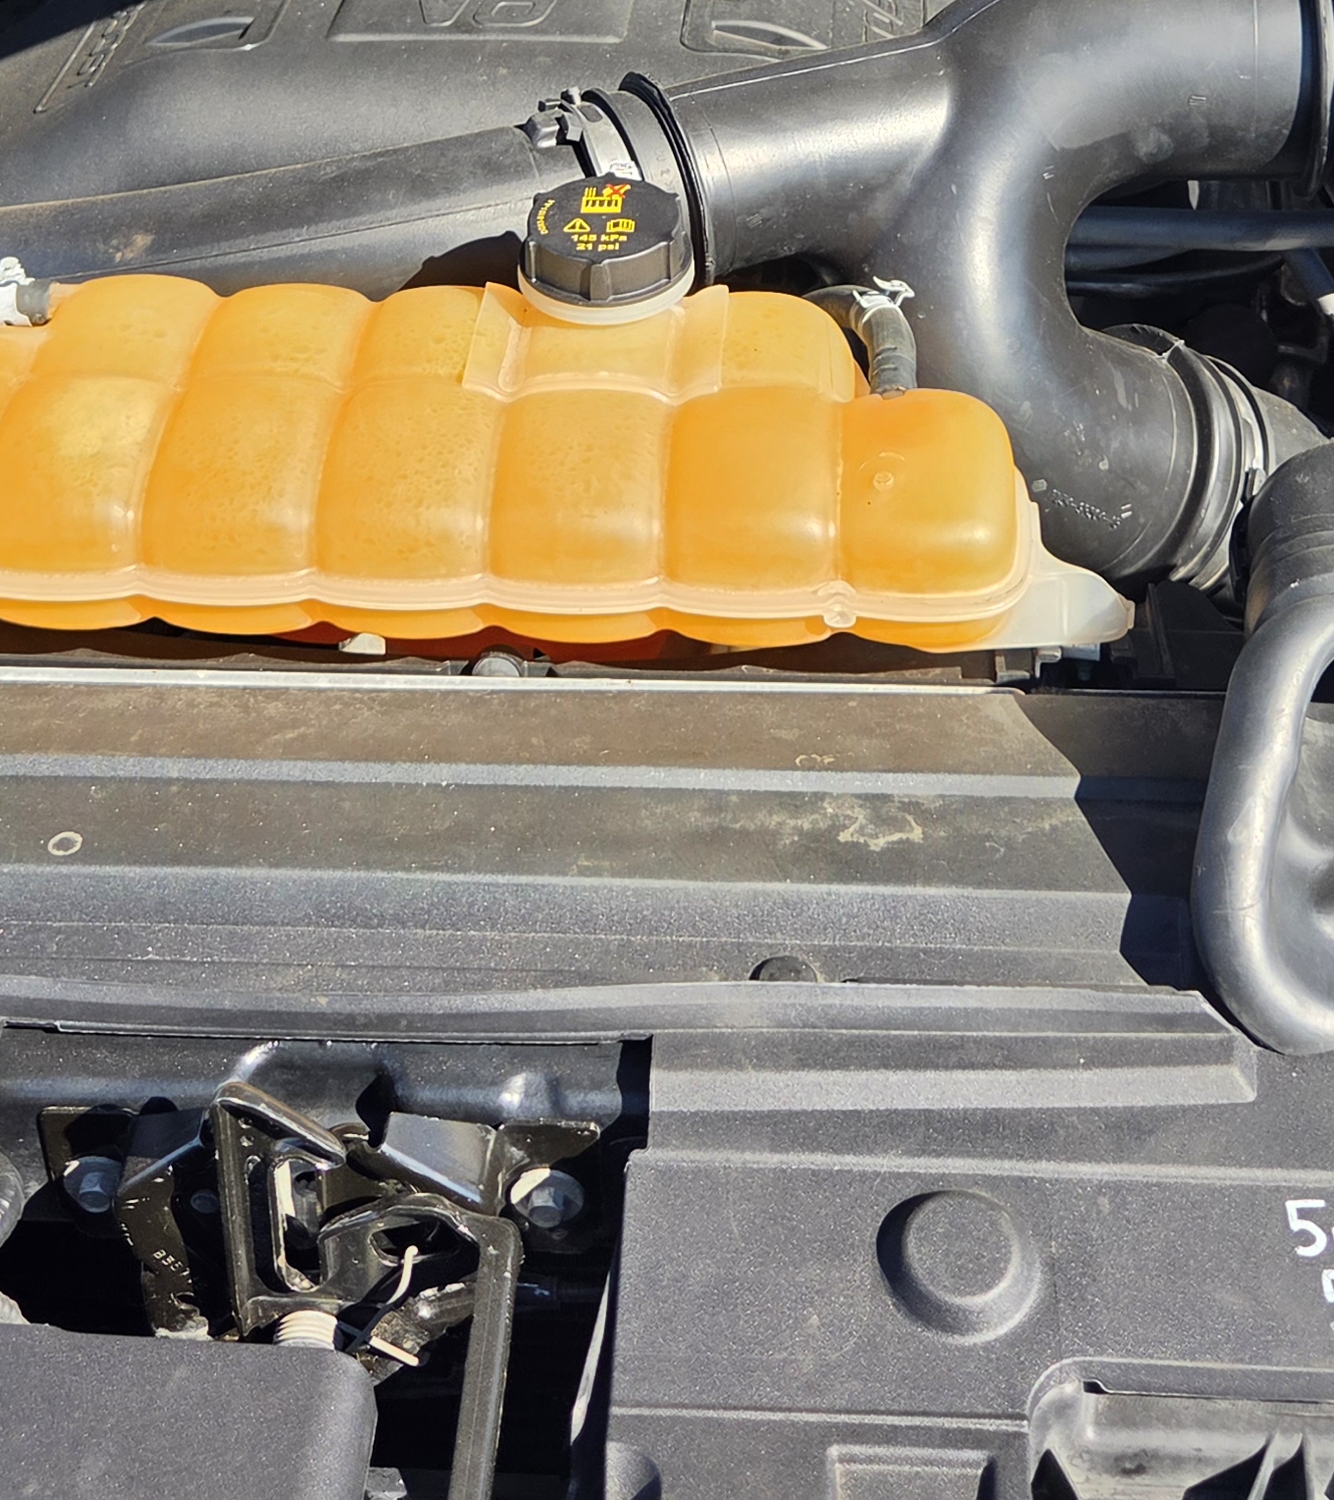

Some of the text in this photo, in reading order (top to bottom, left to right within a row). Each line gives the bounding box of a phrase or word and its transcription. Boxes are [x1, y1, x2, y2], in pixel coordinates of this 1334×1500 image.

[571, 234, 628, 242] 145 kPa
[575, 242, 620, 252] 21 psi
